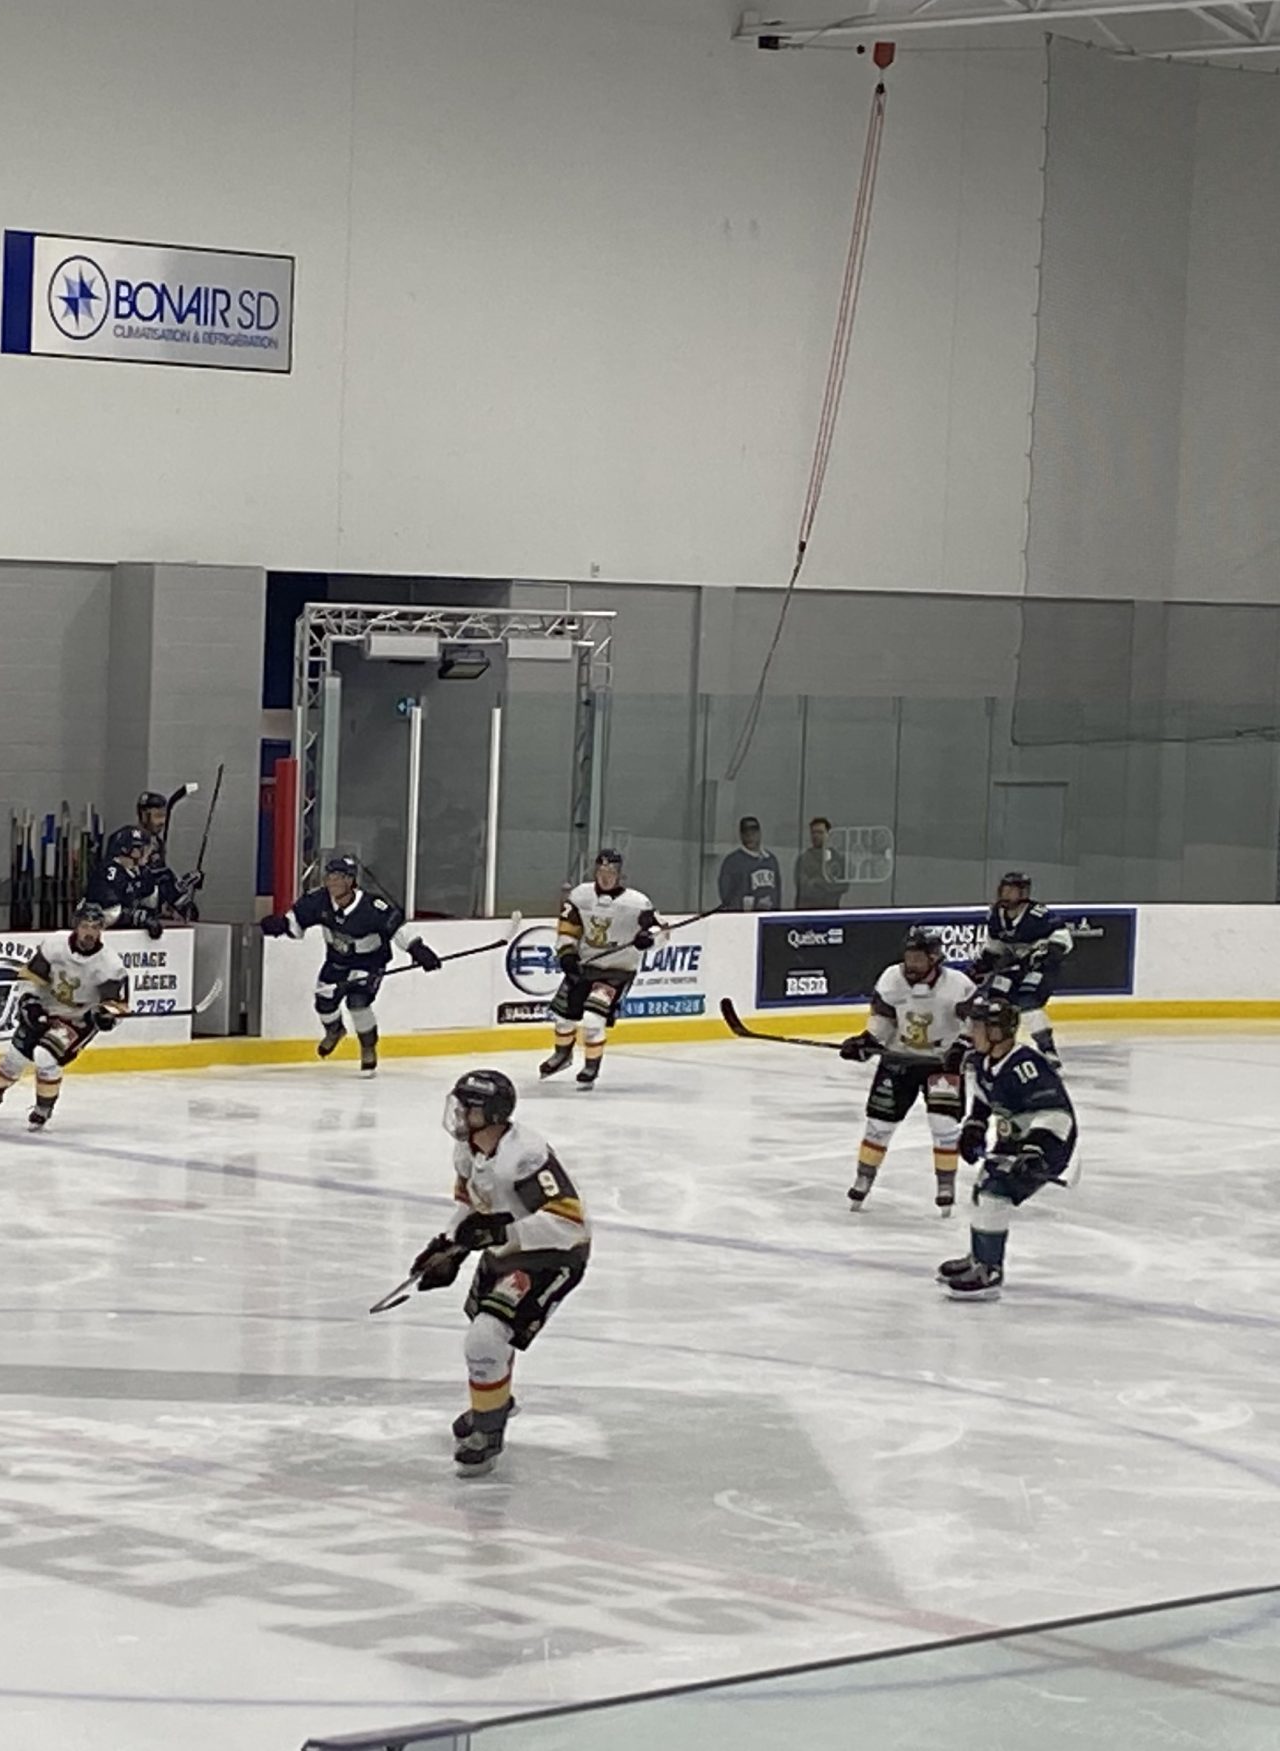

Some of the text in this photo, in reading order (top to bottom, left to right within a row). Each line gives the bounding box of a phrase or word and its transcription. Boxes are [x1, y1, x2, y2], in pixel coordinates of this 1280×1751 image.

[115, 279, 279, 330] BONAIR SD
[113, 325, 191, 345] CLIMATISATION
[640, 945, 702, 974] LANTE
[134, 970, 177, 991] LÉGER
[1013, 1060, 1038, 1085] 10
